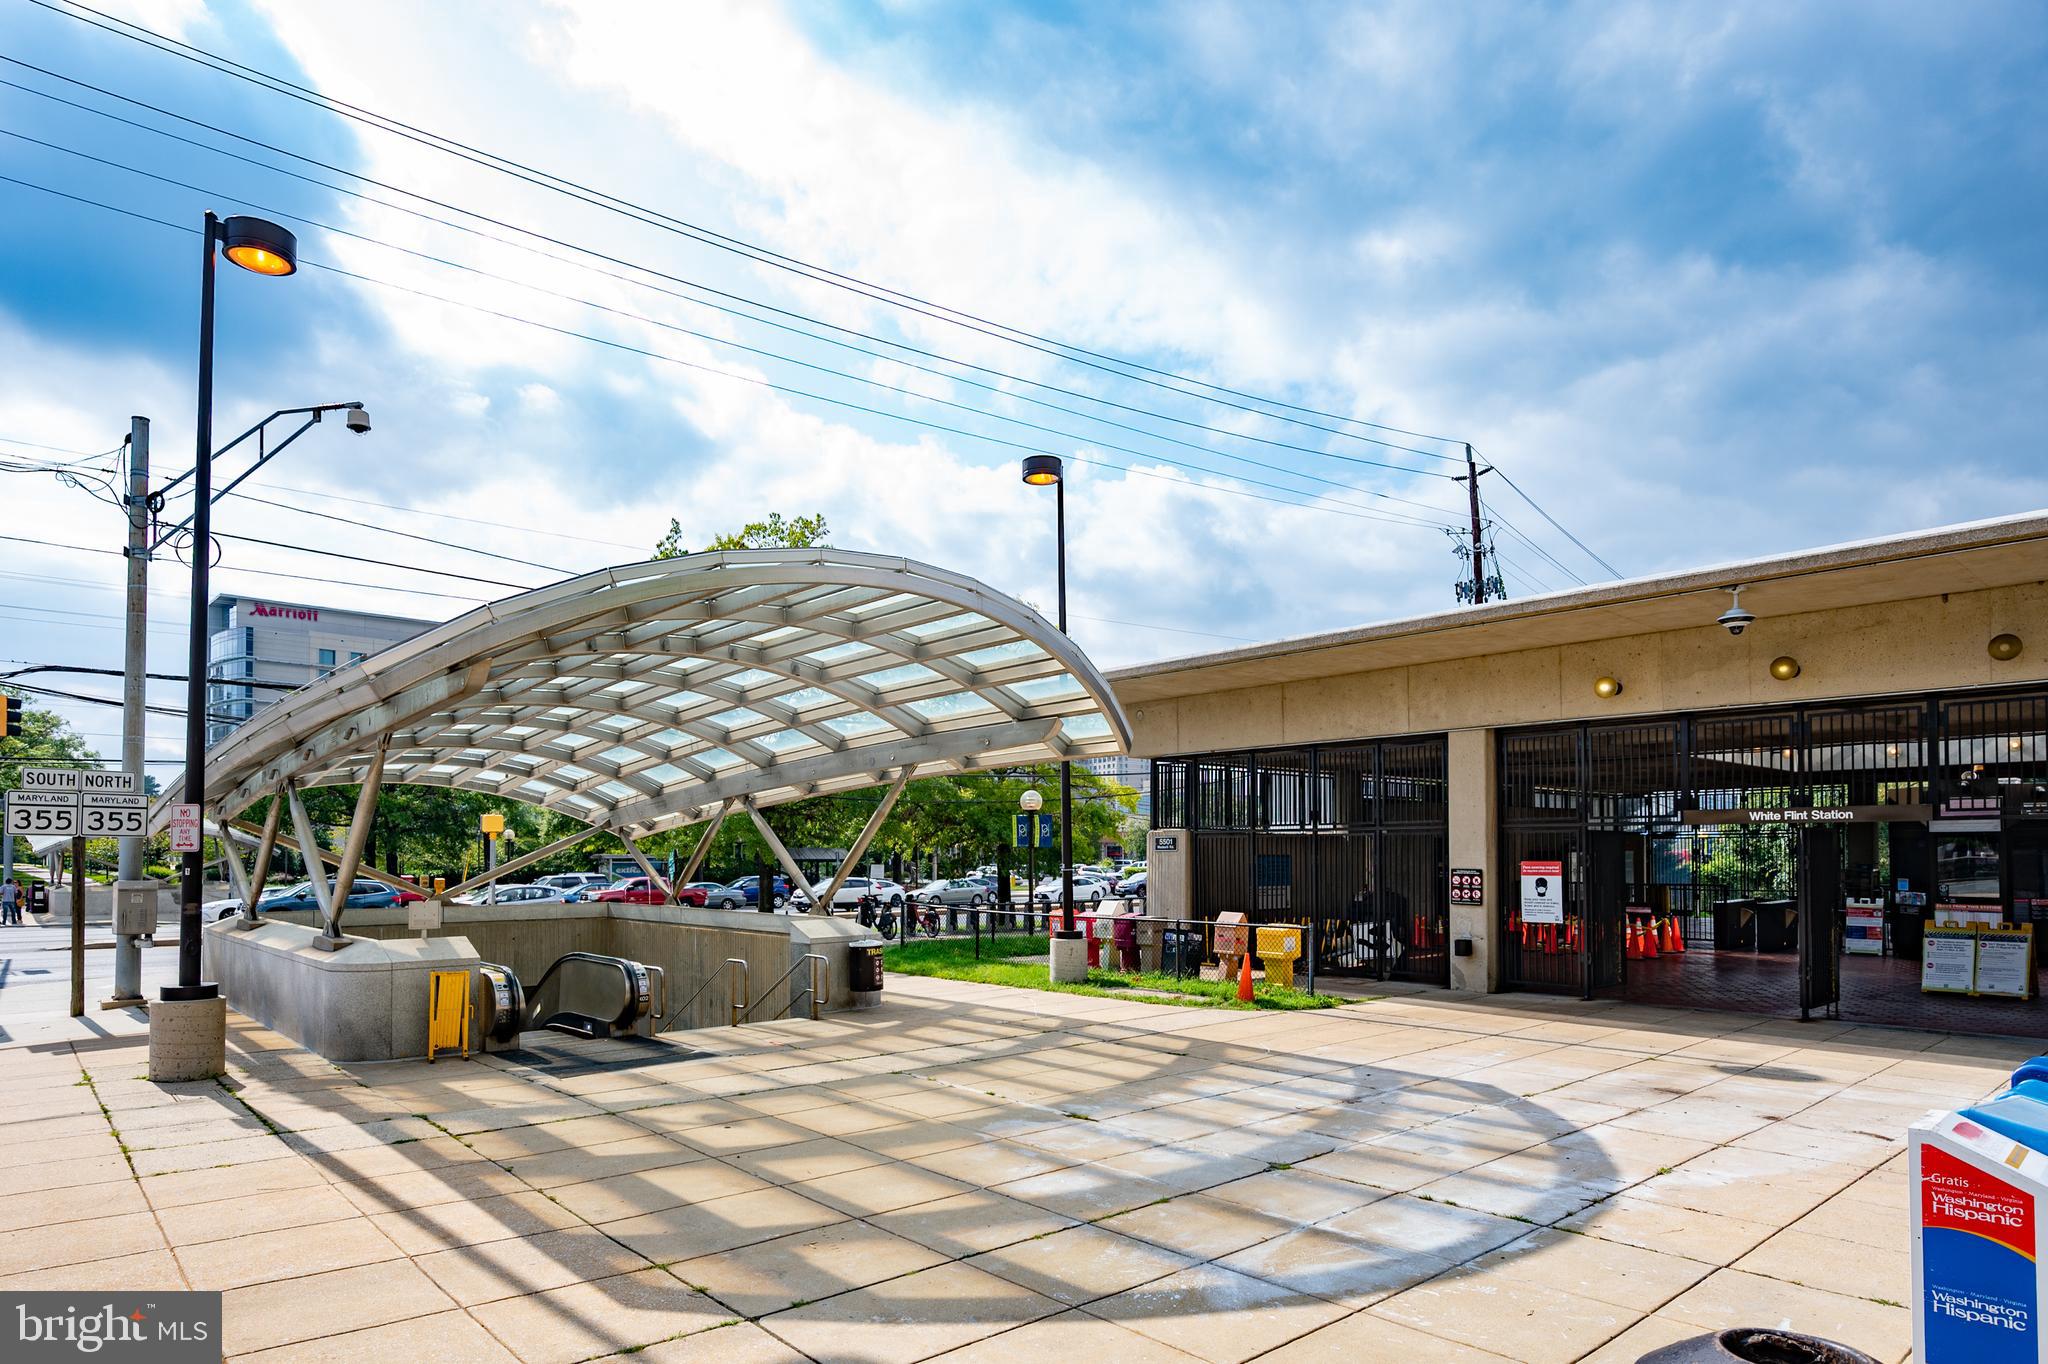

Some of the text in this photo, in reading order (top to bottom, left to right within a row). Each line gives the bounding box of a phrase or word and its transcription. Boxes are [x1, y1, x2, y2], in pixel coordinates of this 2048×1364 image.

[249, 602, 319, 621] Marriott
[26, 772, 76, 787] SOUTH
[85, 774, 132, 789] NORTH
[17, 793, 69, 803] MARYLAND
[91, 796, 140, 805] MARYLAND
[14, 809, 72, 831] 355
[179, 808, 191, 817] NO
[1749, 809, 1854, 821] White Flint Station
[87, 811, 142, 832] 355
[172, 819, 198, 828] STOPPING
[178, 835, 192, 843] TIME
[1931, 1173, 1969, 1188] Gratis
[1931, 1186, 2024, 1205] Washington Maryland Virginia
[1931, 1191, 2025, 1216] Washington
[1932, 1201, 2024, 1228] Hispanic
[1931, 1284, 2027, 1308] Washington Maryland Virginia
[1931, 1289, 2028, 1320] Washington
[1933, 1300, 2027, 1332] Hispanic
